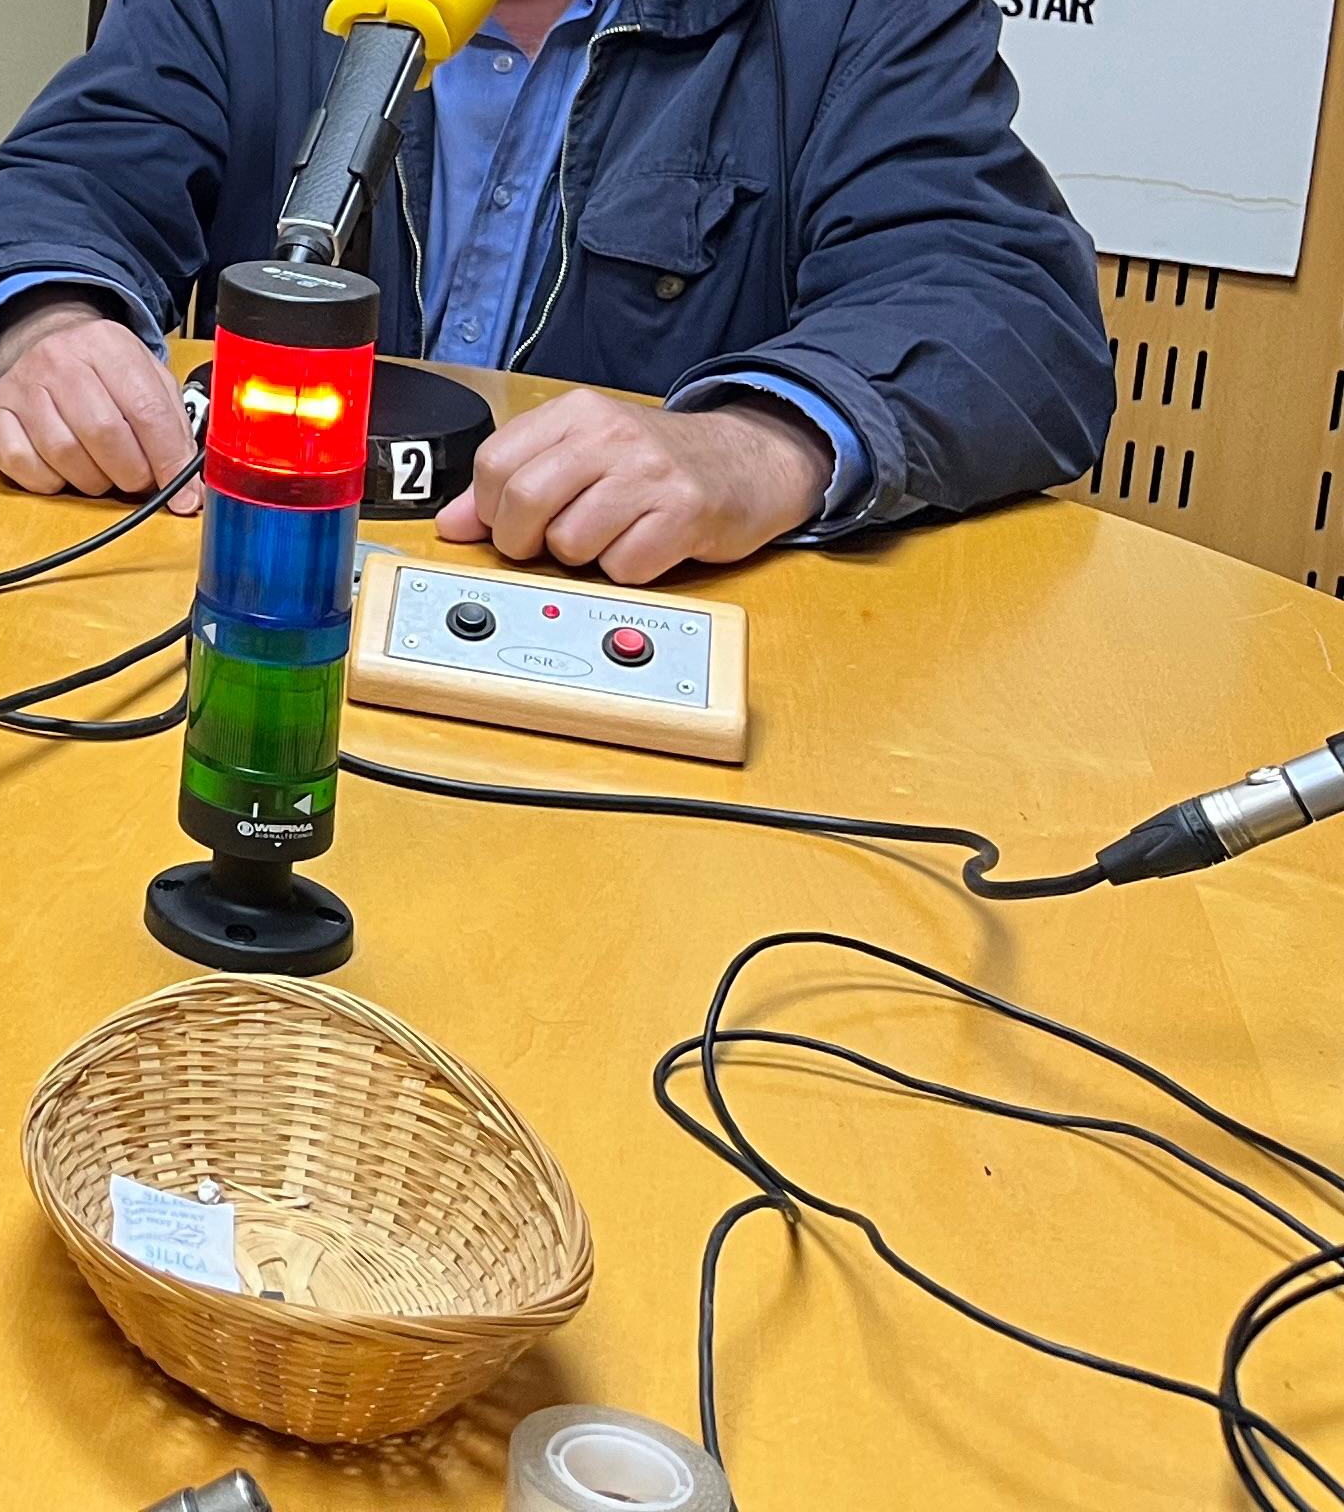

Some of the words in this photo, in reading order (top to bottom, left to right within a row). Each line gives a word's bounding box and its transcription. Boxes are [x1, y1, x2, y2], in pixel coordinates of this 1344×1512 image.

[401, 447, 426, 494] 2
[457, 588, 492, 603] TOS
[588, 608, 671, 631] LLAMADA
[254, 822, 313, 833] WERMA
[145, 1243, 208, 1274] SILICA
